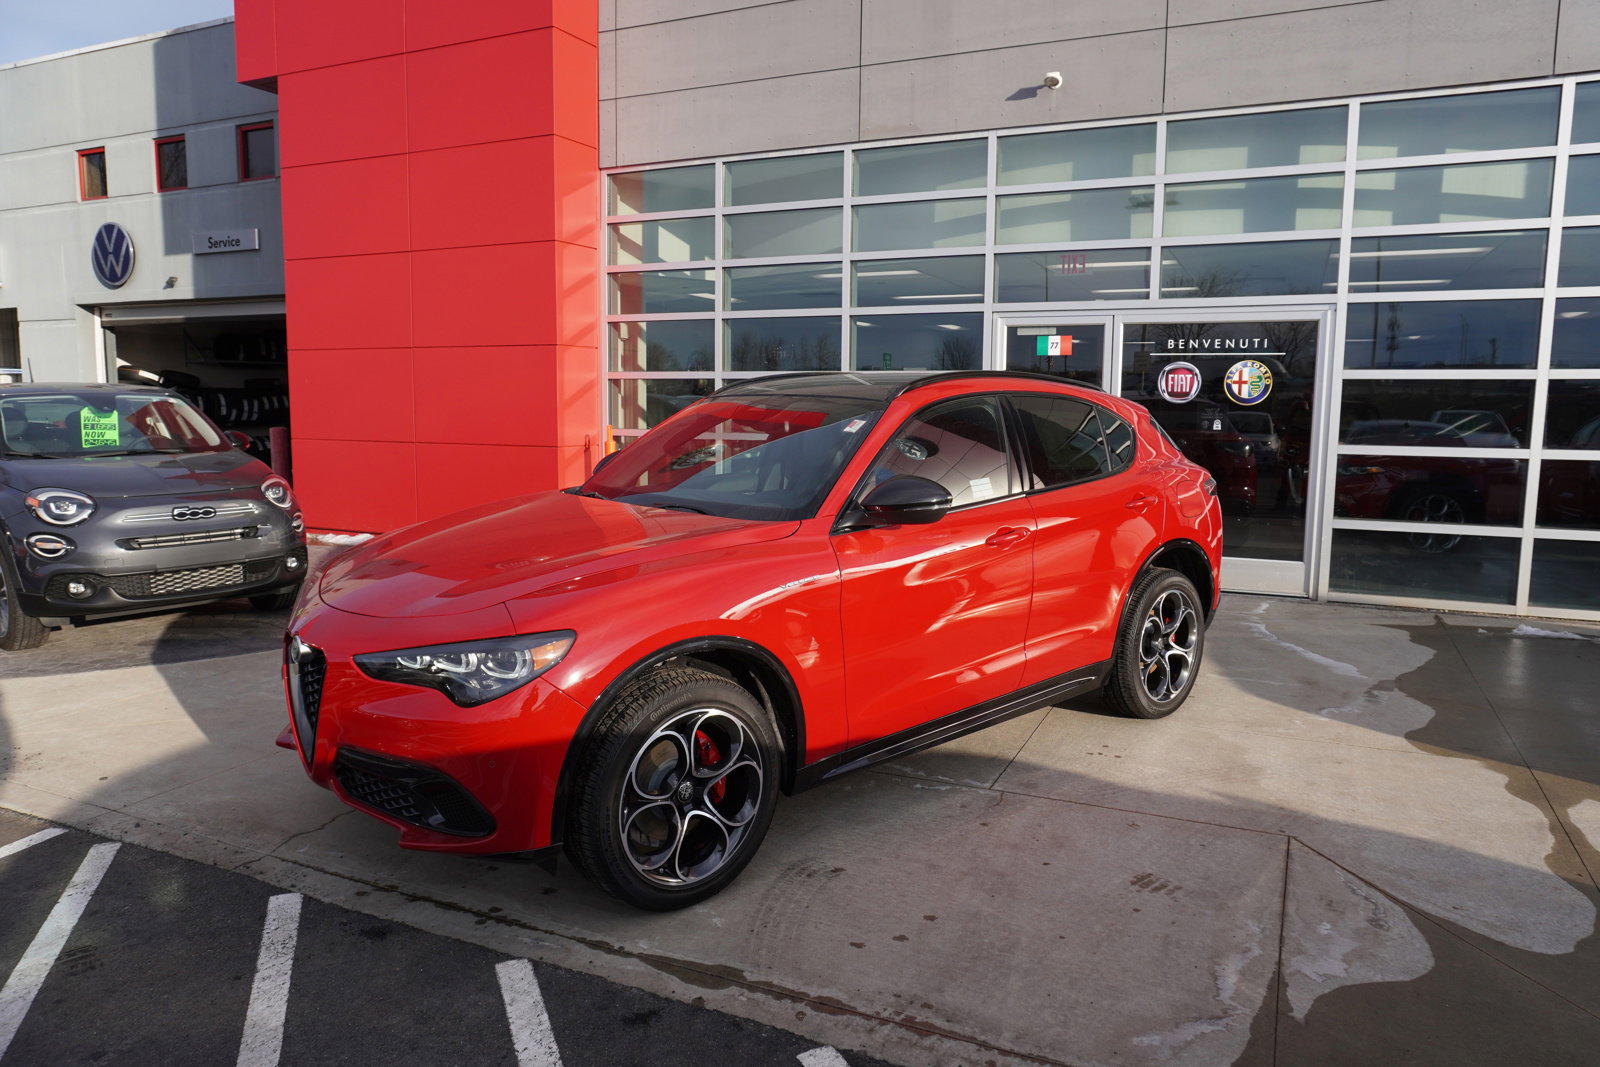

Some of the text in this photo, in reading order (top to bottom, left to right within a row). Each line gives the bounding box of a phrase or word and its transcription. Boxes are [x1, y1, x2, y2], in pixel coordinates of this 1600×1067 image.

[207, 236, 241, 249] Service
[1049, 342, 1059, 350] 77
[1167, 338, 1268, 349] BENVENUTI
[1247, 361, 1271, 385] ROMEO
[1167, 373, 1193, 393] FIAT
[83, 415, 101, 423] WAS
[84, 431, 106, 439] NOW
[172, 506, 216, 521] 500
